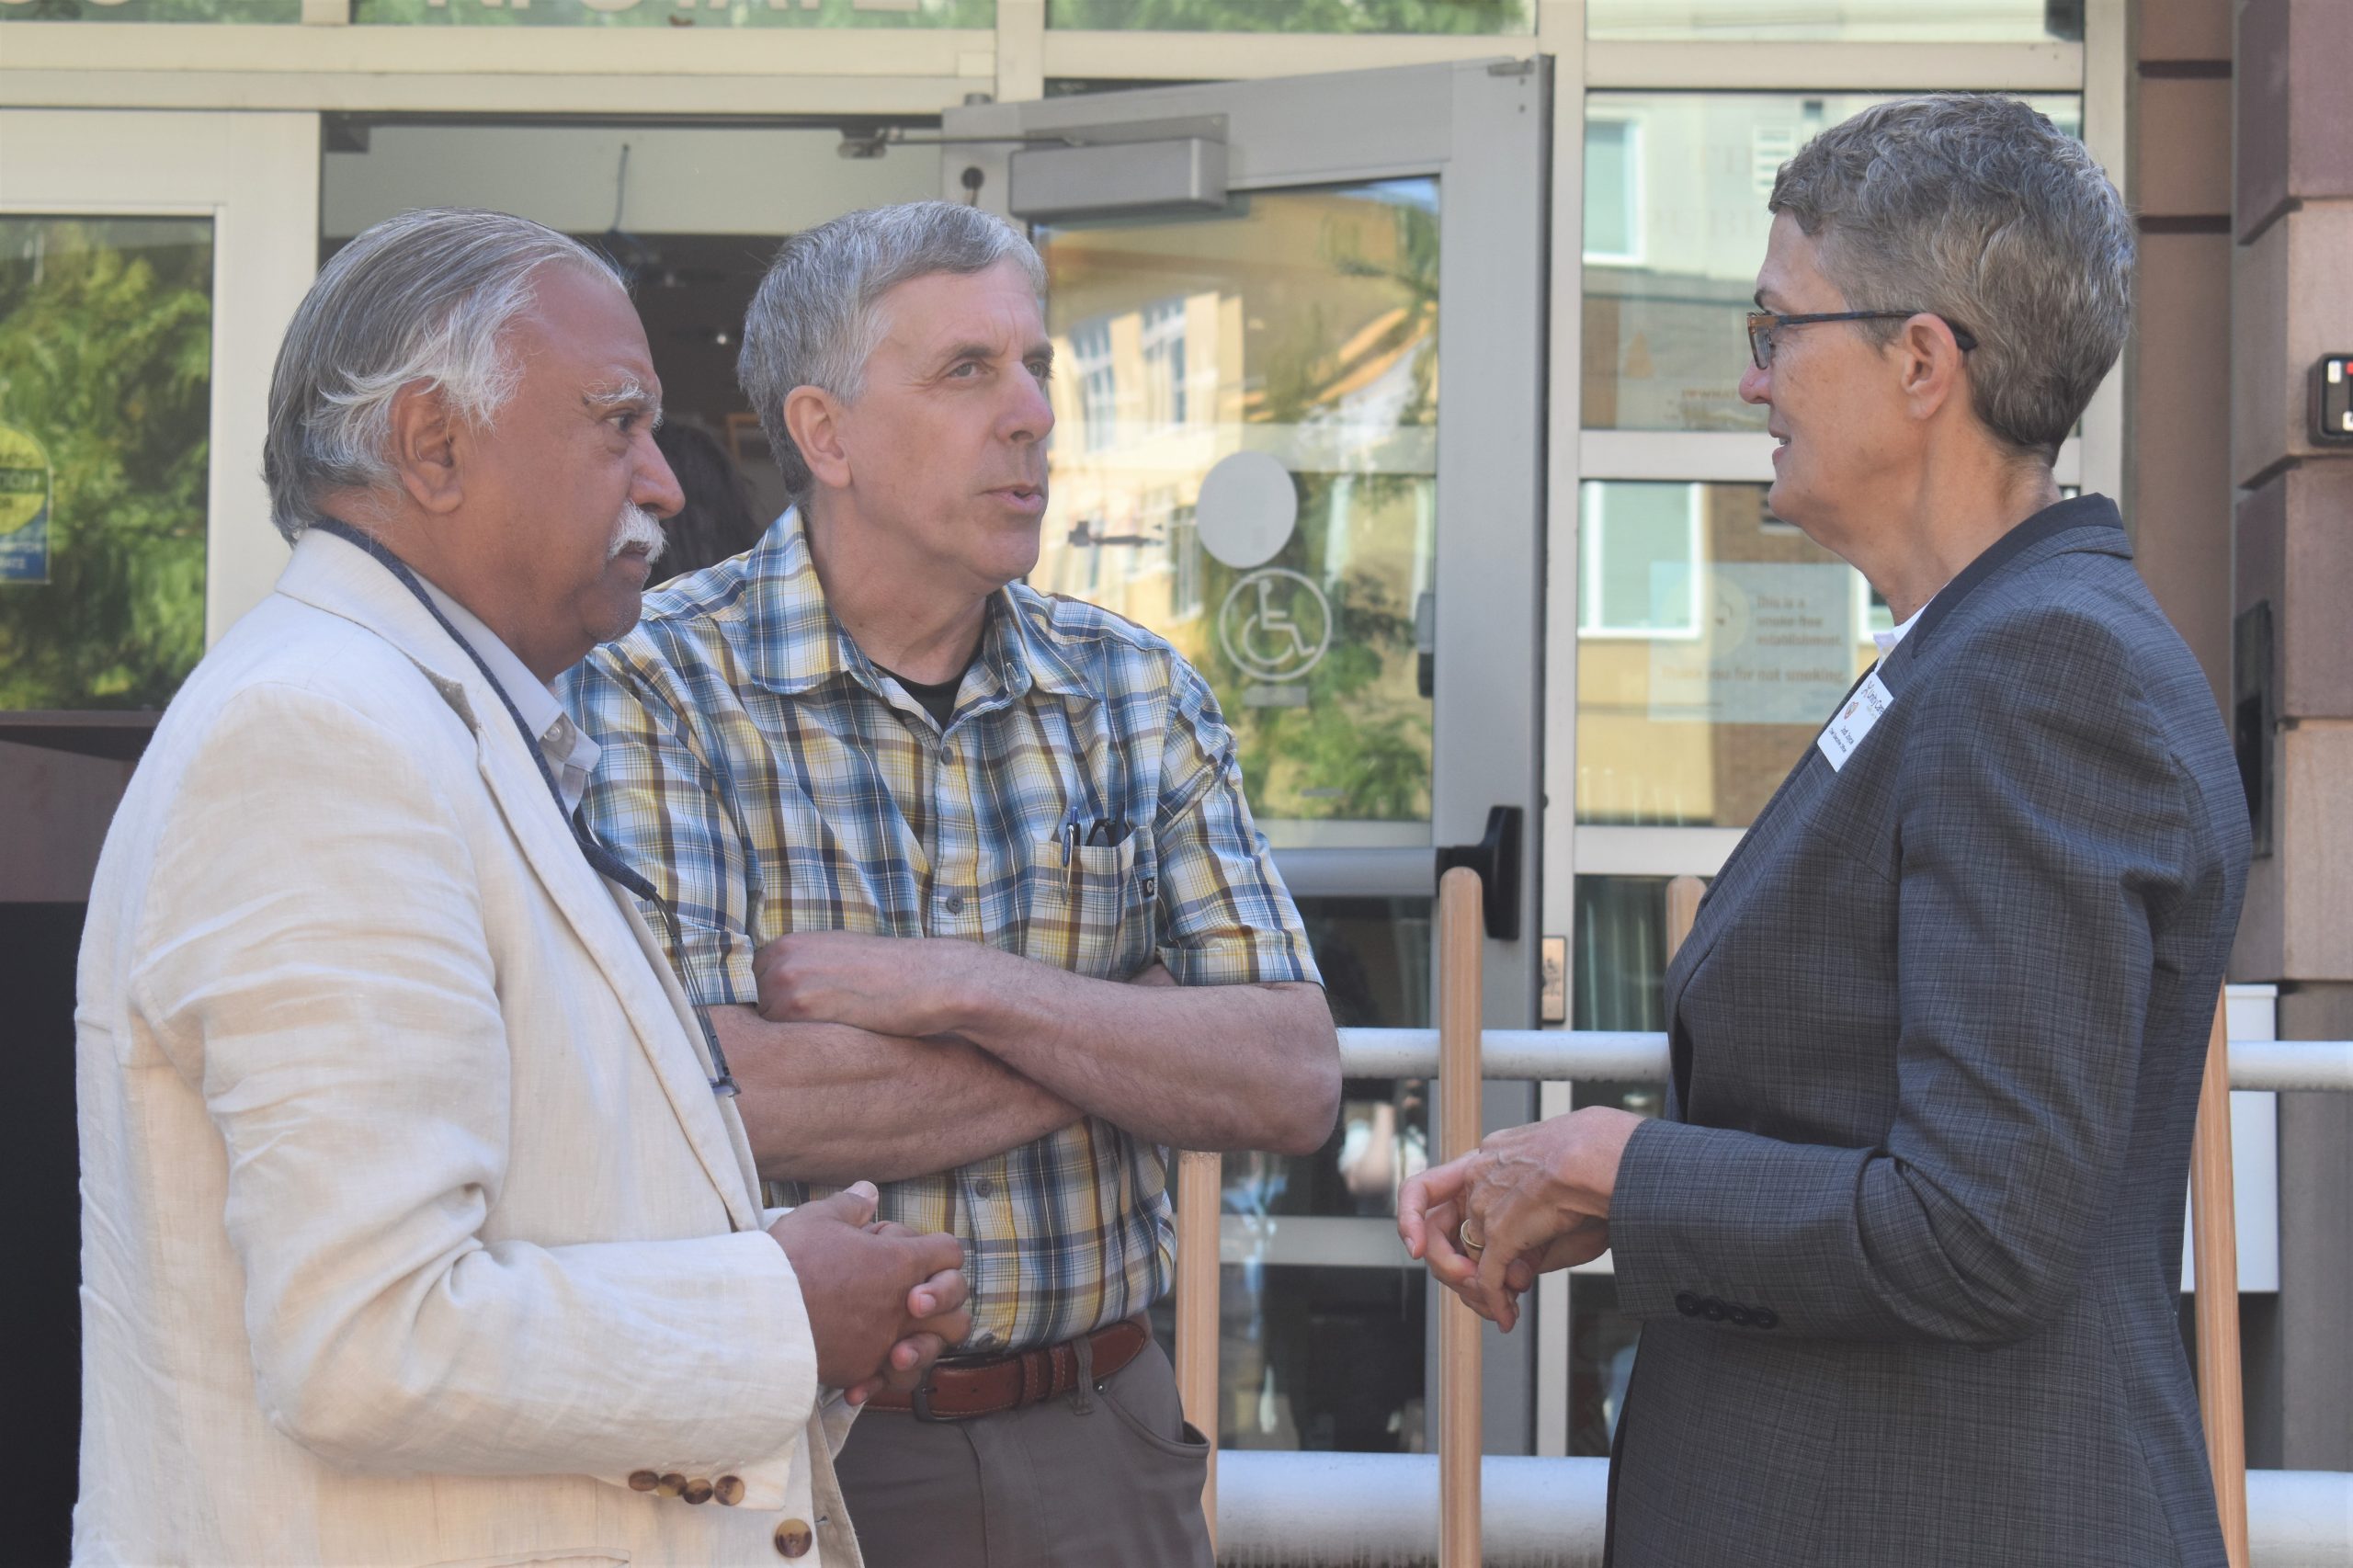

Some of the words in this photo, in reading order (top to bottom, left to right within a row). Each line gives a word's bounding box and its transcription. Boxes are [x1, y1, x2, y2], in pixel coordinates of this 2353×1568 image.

[1756, 596, 1780, 608] This
[1783, 597, 1794, 608] is
[1734, 666, 1753, 680] for
[1757, 667, 1780, 680] not
